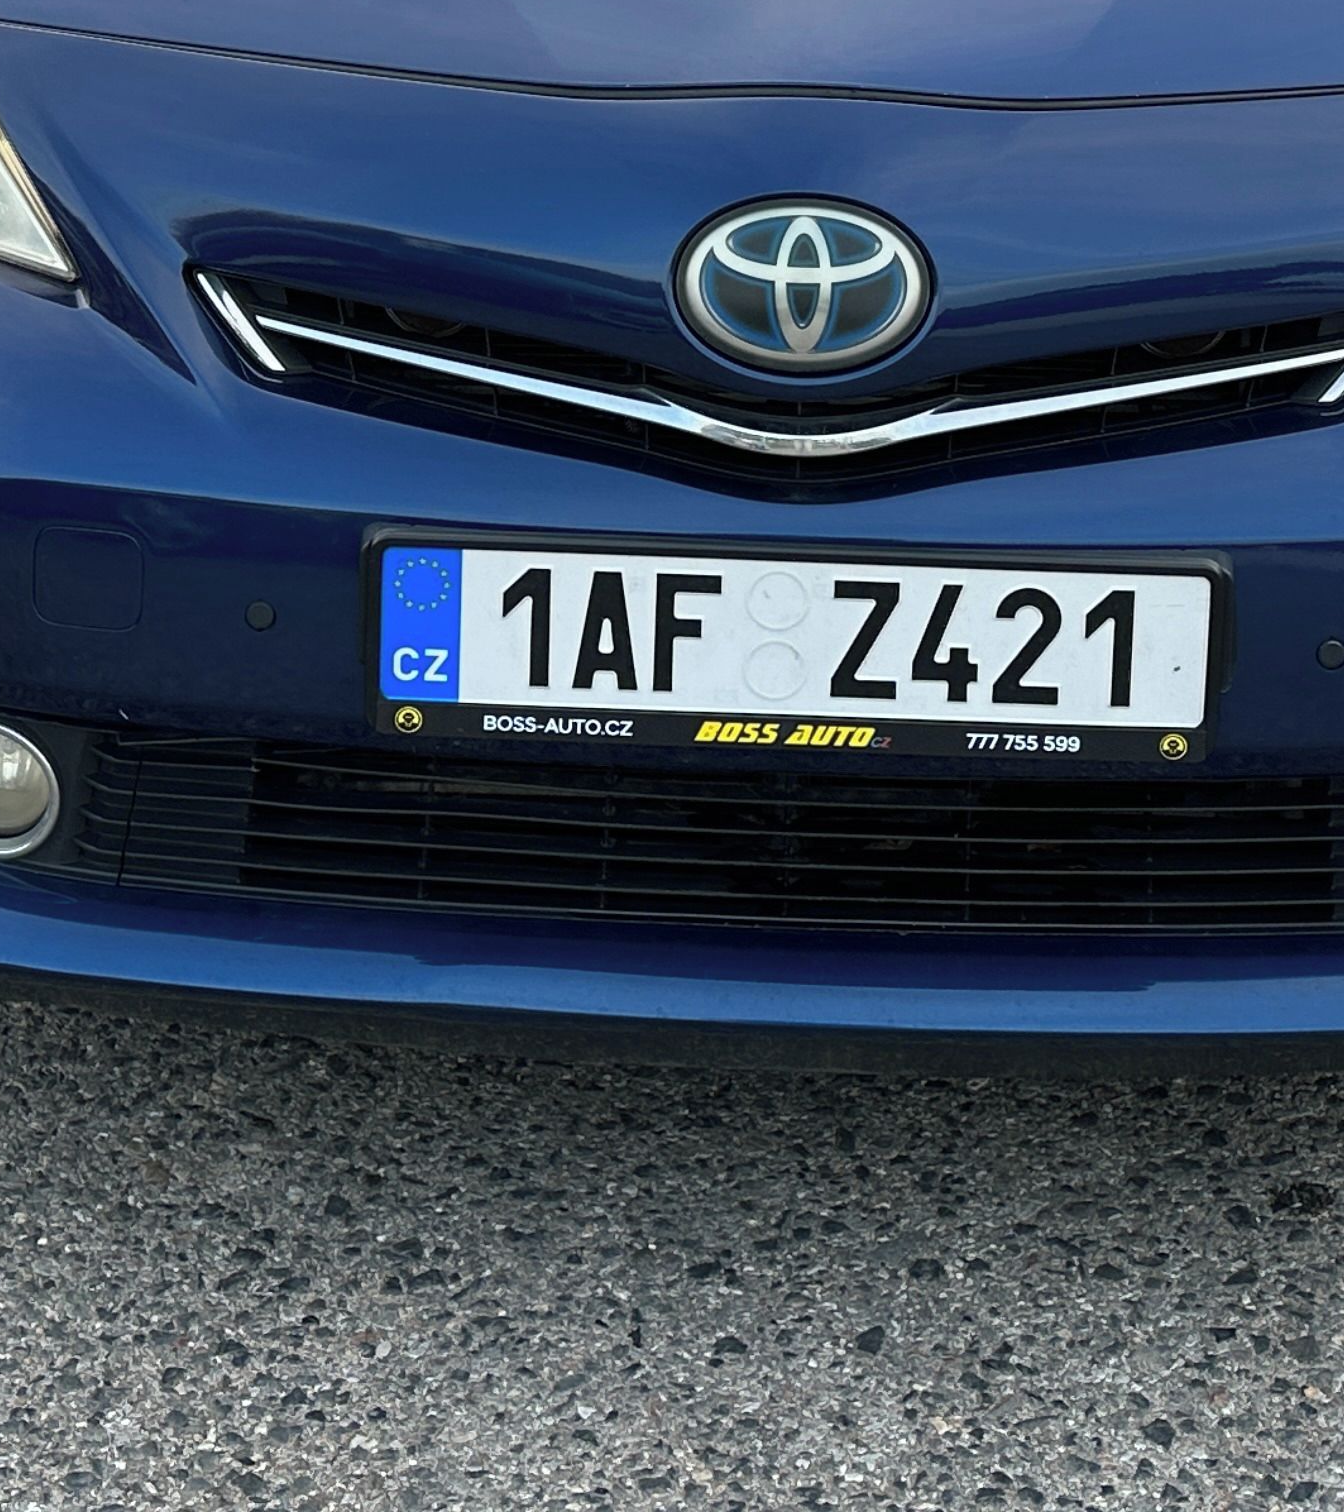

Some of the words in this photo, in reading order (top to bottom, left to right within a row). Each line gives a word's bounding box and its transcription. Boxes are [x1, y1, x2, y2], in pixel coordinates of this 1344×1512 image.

[502, 567, 723, 692] 1AF
[830, 579, 1136, 708] Z421
[392, 646, 449, 683] CZ
[483, 714, 635, 738] BOSS-AUTO.CZ
[694, 721, 781, 744] BOSS
[783, 724, 877, 748] AUTO
[965, 733, 1000, 751] 777
[1003, 734, 1039, 752] 755
[1043, 735, 1081, 753] 599
